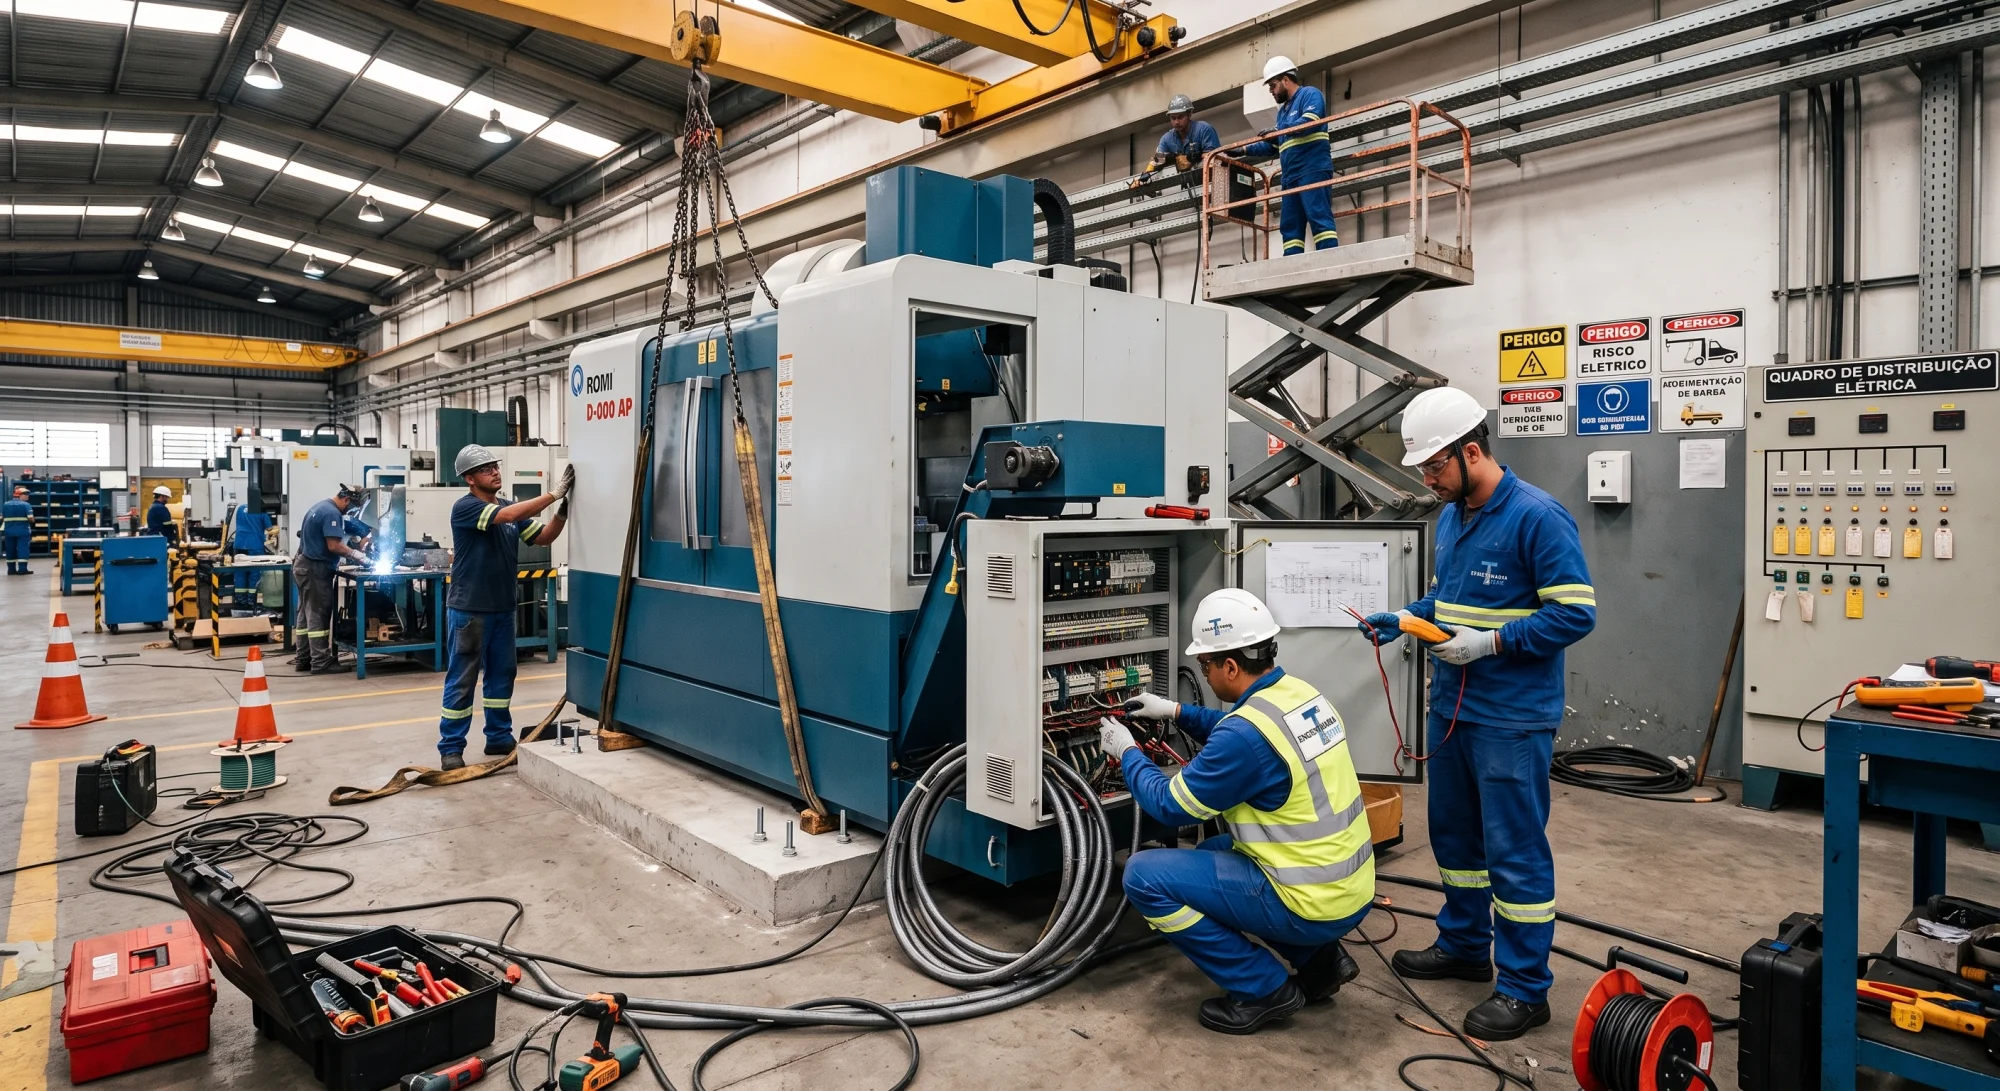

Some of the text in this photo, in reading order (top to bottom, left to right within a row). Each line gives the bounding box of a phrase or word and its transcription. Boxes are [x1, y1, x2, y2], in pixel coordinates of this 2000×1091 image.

[1671, 316, 1731, 329] PERIGO
[1504, 331, 1562, 348] PERIGO
[1587, 325, 1641, 340] PERIGO
[1593, 346, 1634, 358] RISCO
[1581, 359, 1647, 373] ELETRICO
[1769, 356, 1992, 384] QUADRO DE DISTRIBUIÇÃO
[586, 372, 613, 395] ROMI
[1835, 378, 1917, 394] ELÉTRICA
[1510, 391, 1555, 402] PERIGO
[1678, 390, 1690, 398] DE
[617, 397, 633, 418] AP
[1531, 424, 1545, 432] OE
